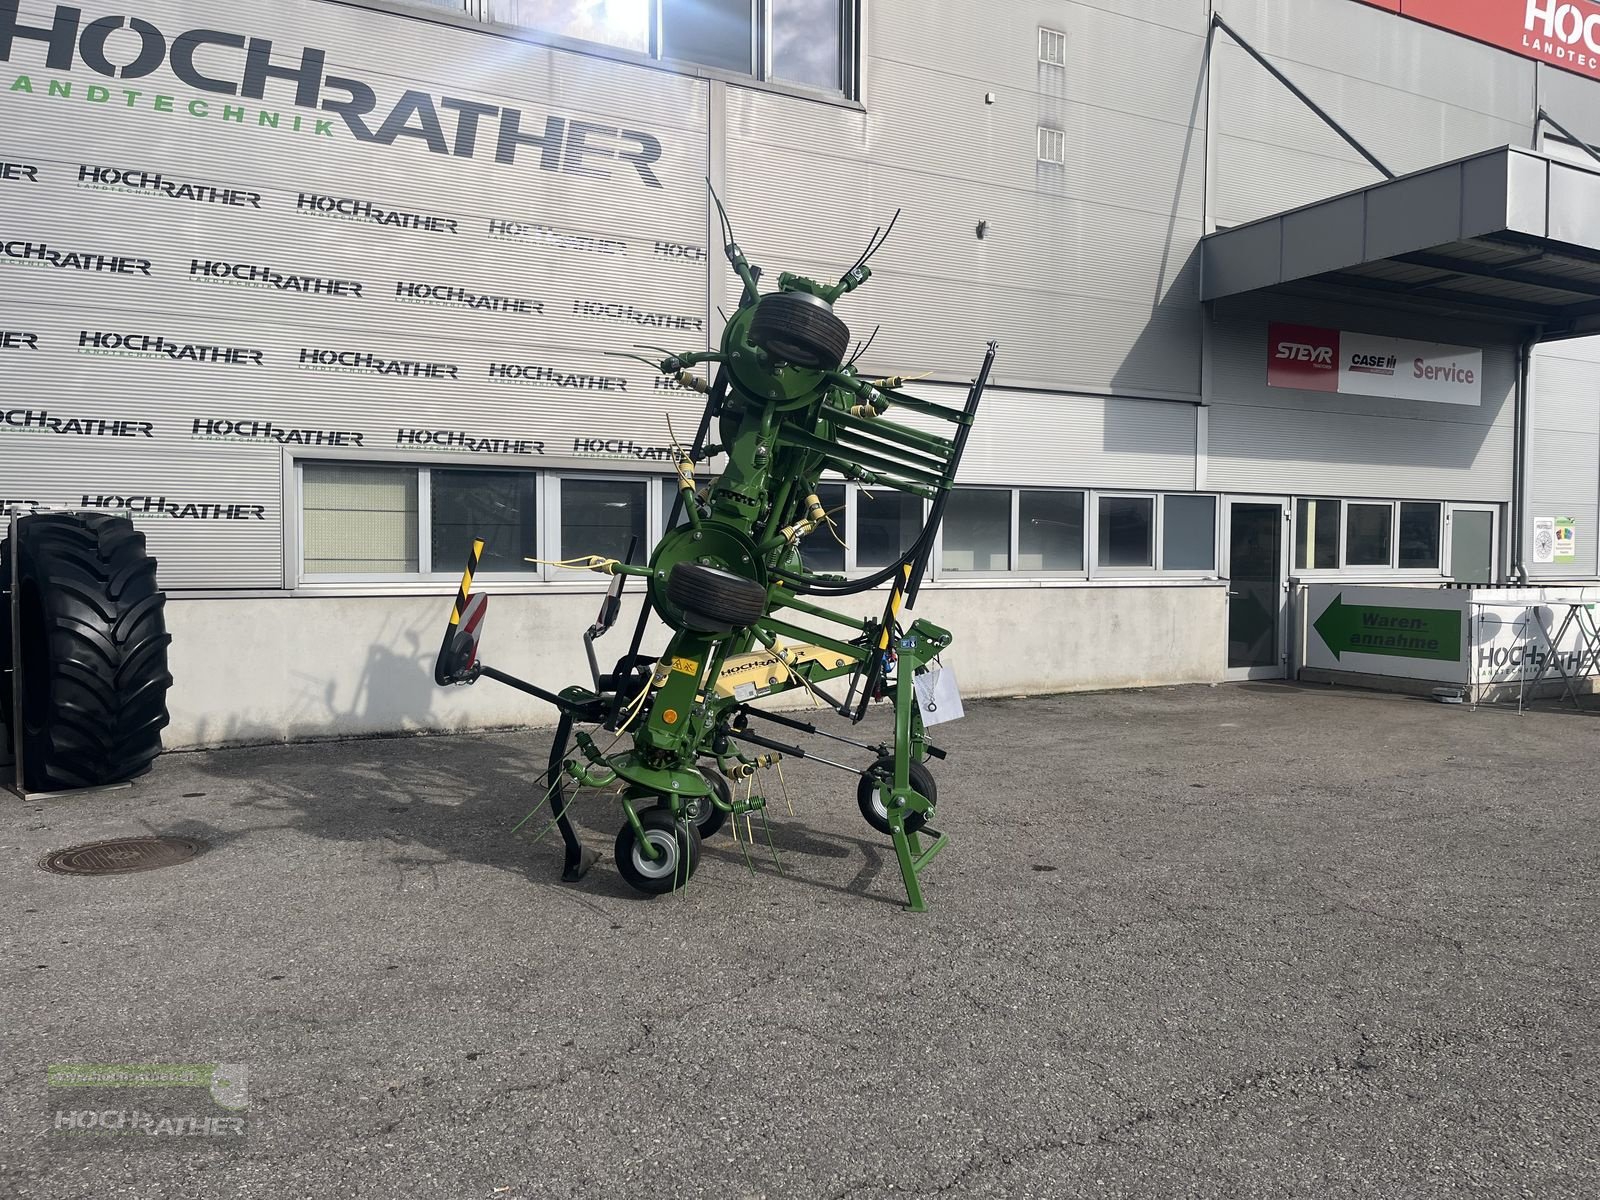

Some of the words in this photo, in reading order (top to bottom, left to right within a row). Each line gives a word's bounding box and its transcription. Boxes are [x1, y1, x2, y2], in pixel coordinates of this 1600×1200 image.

[0, 0, 663, 188] HOCHRATHER
[78, 165, 261, 209] HOCHRATHER
[297, 193, 458, 234] HOCHRATHER
[0, 241, 152, 276] CHRATHER
[190, 259, 362, 298] HOCHRATHER
[395, 281, 544, 314] HOCHRATHER
[79, 331, 263, 366] HOCHRATHER
[1275, 342, 1333, 364] STEYR
[1351, 354, 1386, 368] CASE
[299, 348, 458, 379] HOCHRATHER
[489, 363, 627, 391] HOCHRATHER
[1413, 358, 1475, 385] Service
[0, 409, 153, 437] CHRATHER
[192, 418, 363, 447] HOCHRATHER
[396, 429, 544, 454] HOCHRATHER
[1363, 613, 1429, 629] Waren-
[1350, 634, 1439, 650] annahme
